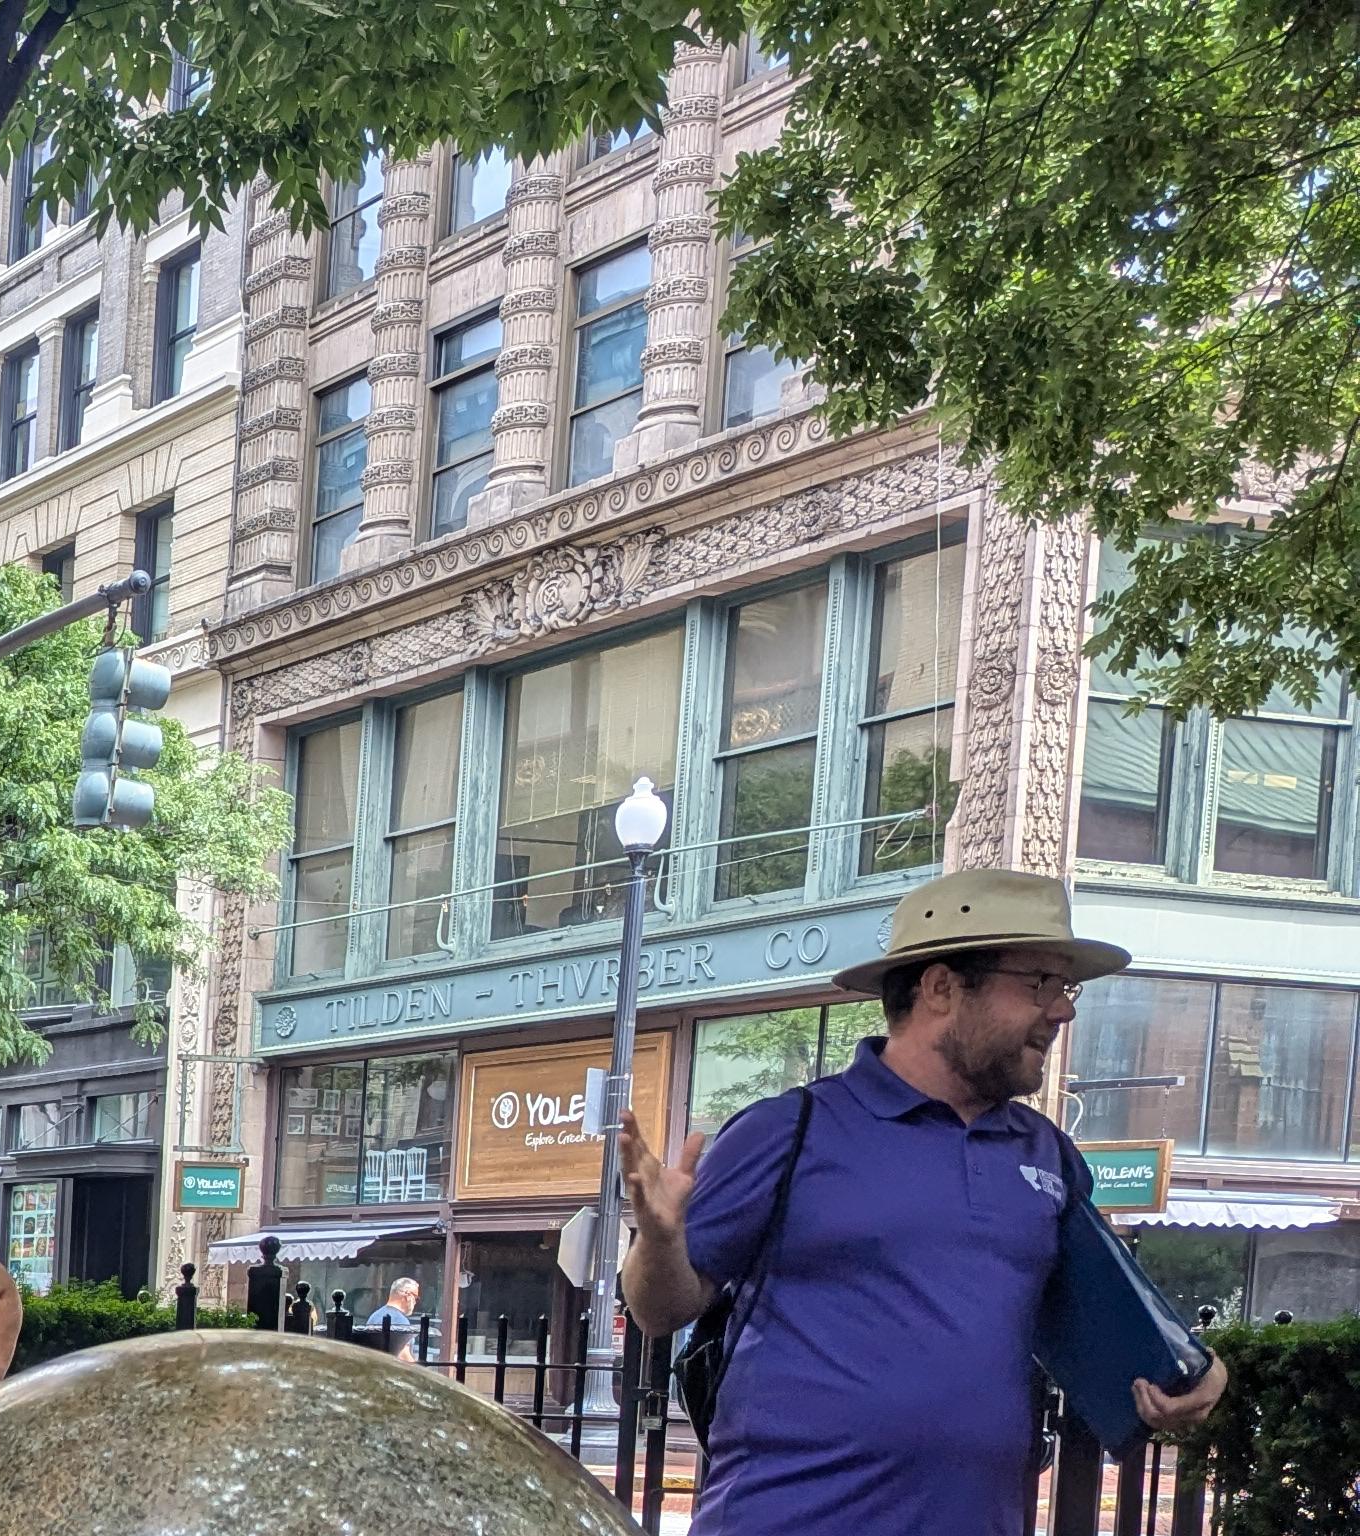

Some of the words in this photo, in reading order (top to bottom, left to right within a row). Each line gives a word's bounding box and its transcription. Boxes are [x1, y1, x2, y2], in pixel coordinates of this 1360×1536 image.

[325, 983, 455, 1033] TILDEN
[764, 923, 831, 970] CO
[526, 1092, 586, 1126] YOLE
[525, 1132, 555, 1151] Explore
[557, 1131, 586, 1144] Greek
[1096, 1165, 1154, 1180] YOLENI'S
